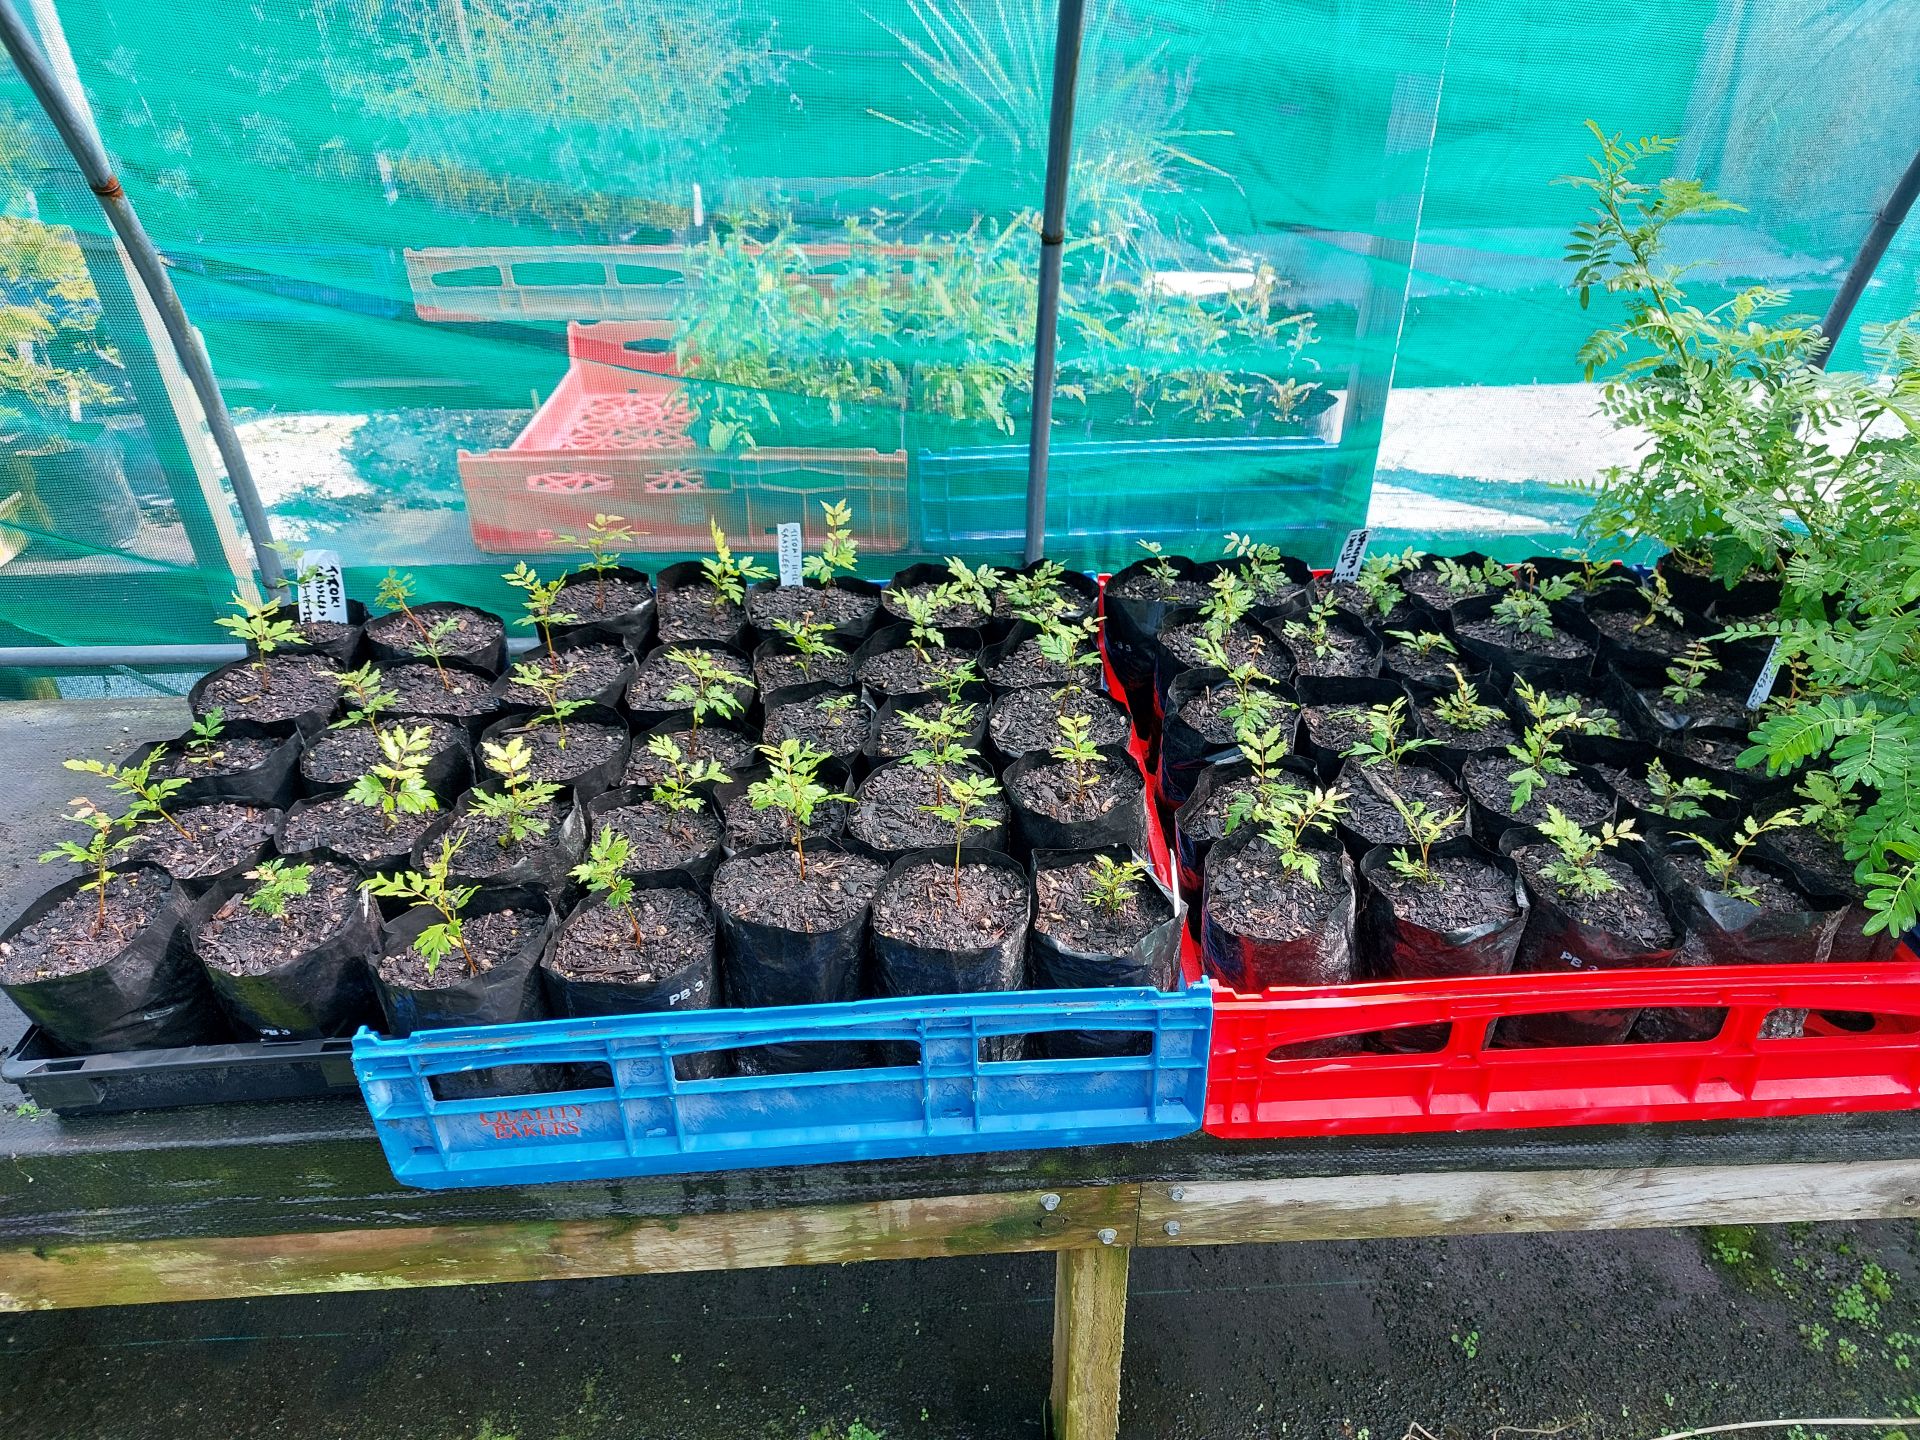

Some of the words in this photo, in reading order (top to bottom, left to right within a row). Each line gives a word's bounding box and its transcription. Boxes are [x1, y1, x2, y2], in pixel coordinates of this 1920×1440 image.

[669, 988, 691, 1006] PB
[694, 980, 704, 992] 3
[480, 1105, 582, 1126] QUALITY
[495, 1120, 580, 1139] BAKERS
